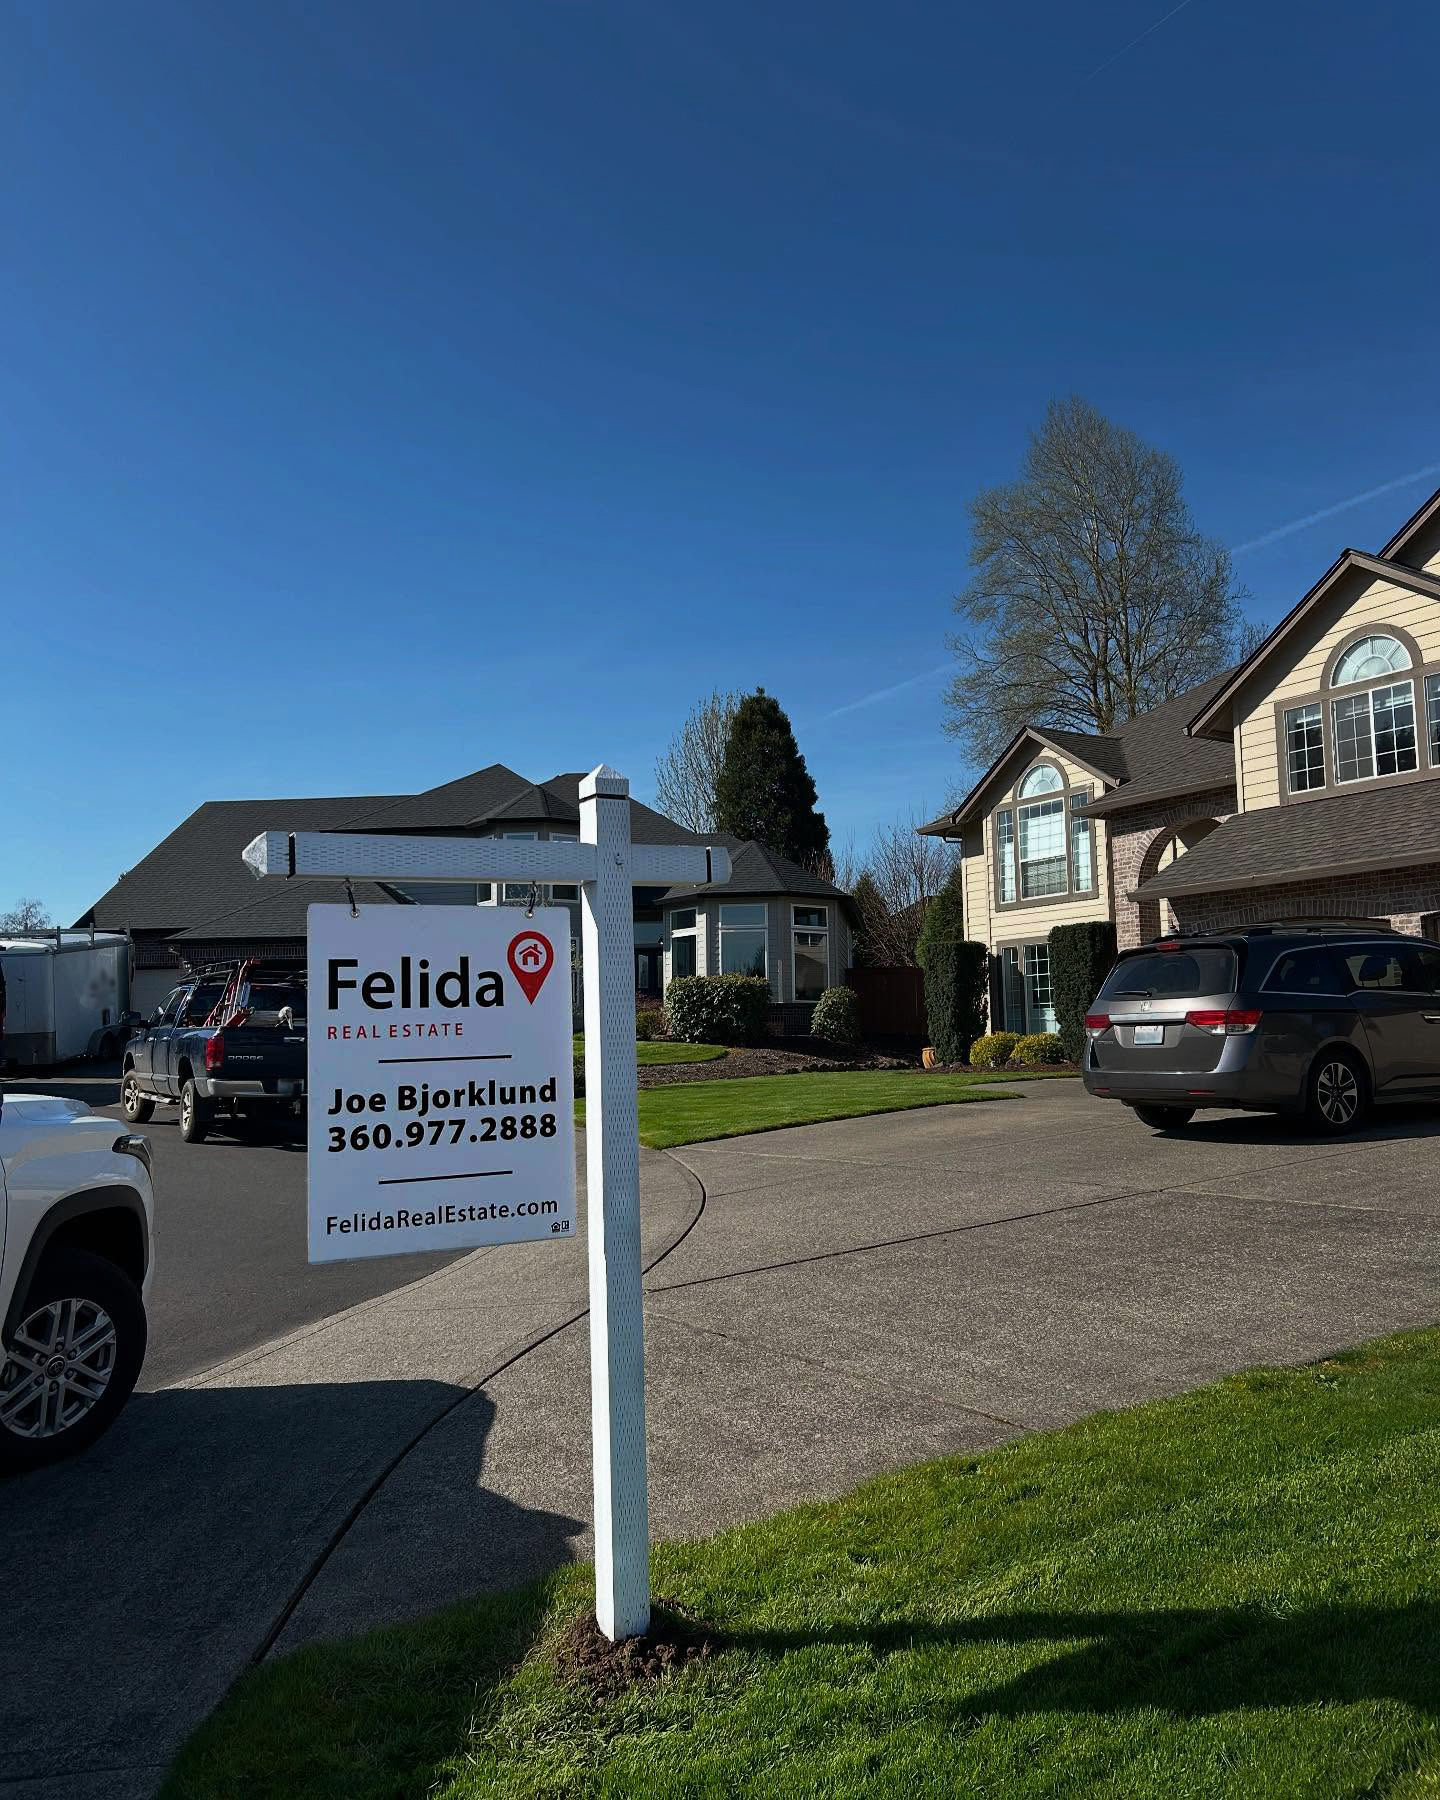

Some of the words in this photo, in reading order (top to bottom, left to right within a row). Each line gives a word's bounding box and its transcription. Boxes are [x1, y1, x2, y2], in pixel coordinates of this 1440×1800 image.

[327, 955, 505, 1011] Felida
[327, 1024, 382, 1040] REAL
[389, 1022, 464, 1038] ESTATE
[327, 1088, 387, 1116] Joe
[397, 1076, 557, 1118] Bjorklund
[327, 1113, 557, 1153] 360.977.2888
[326, 1200, 559, 1236] FelidaRealEstate.com
